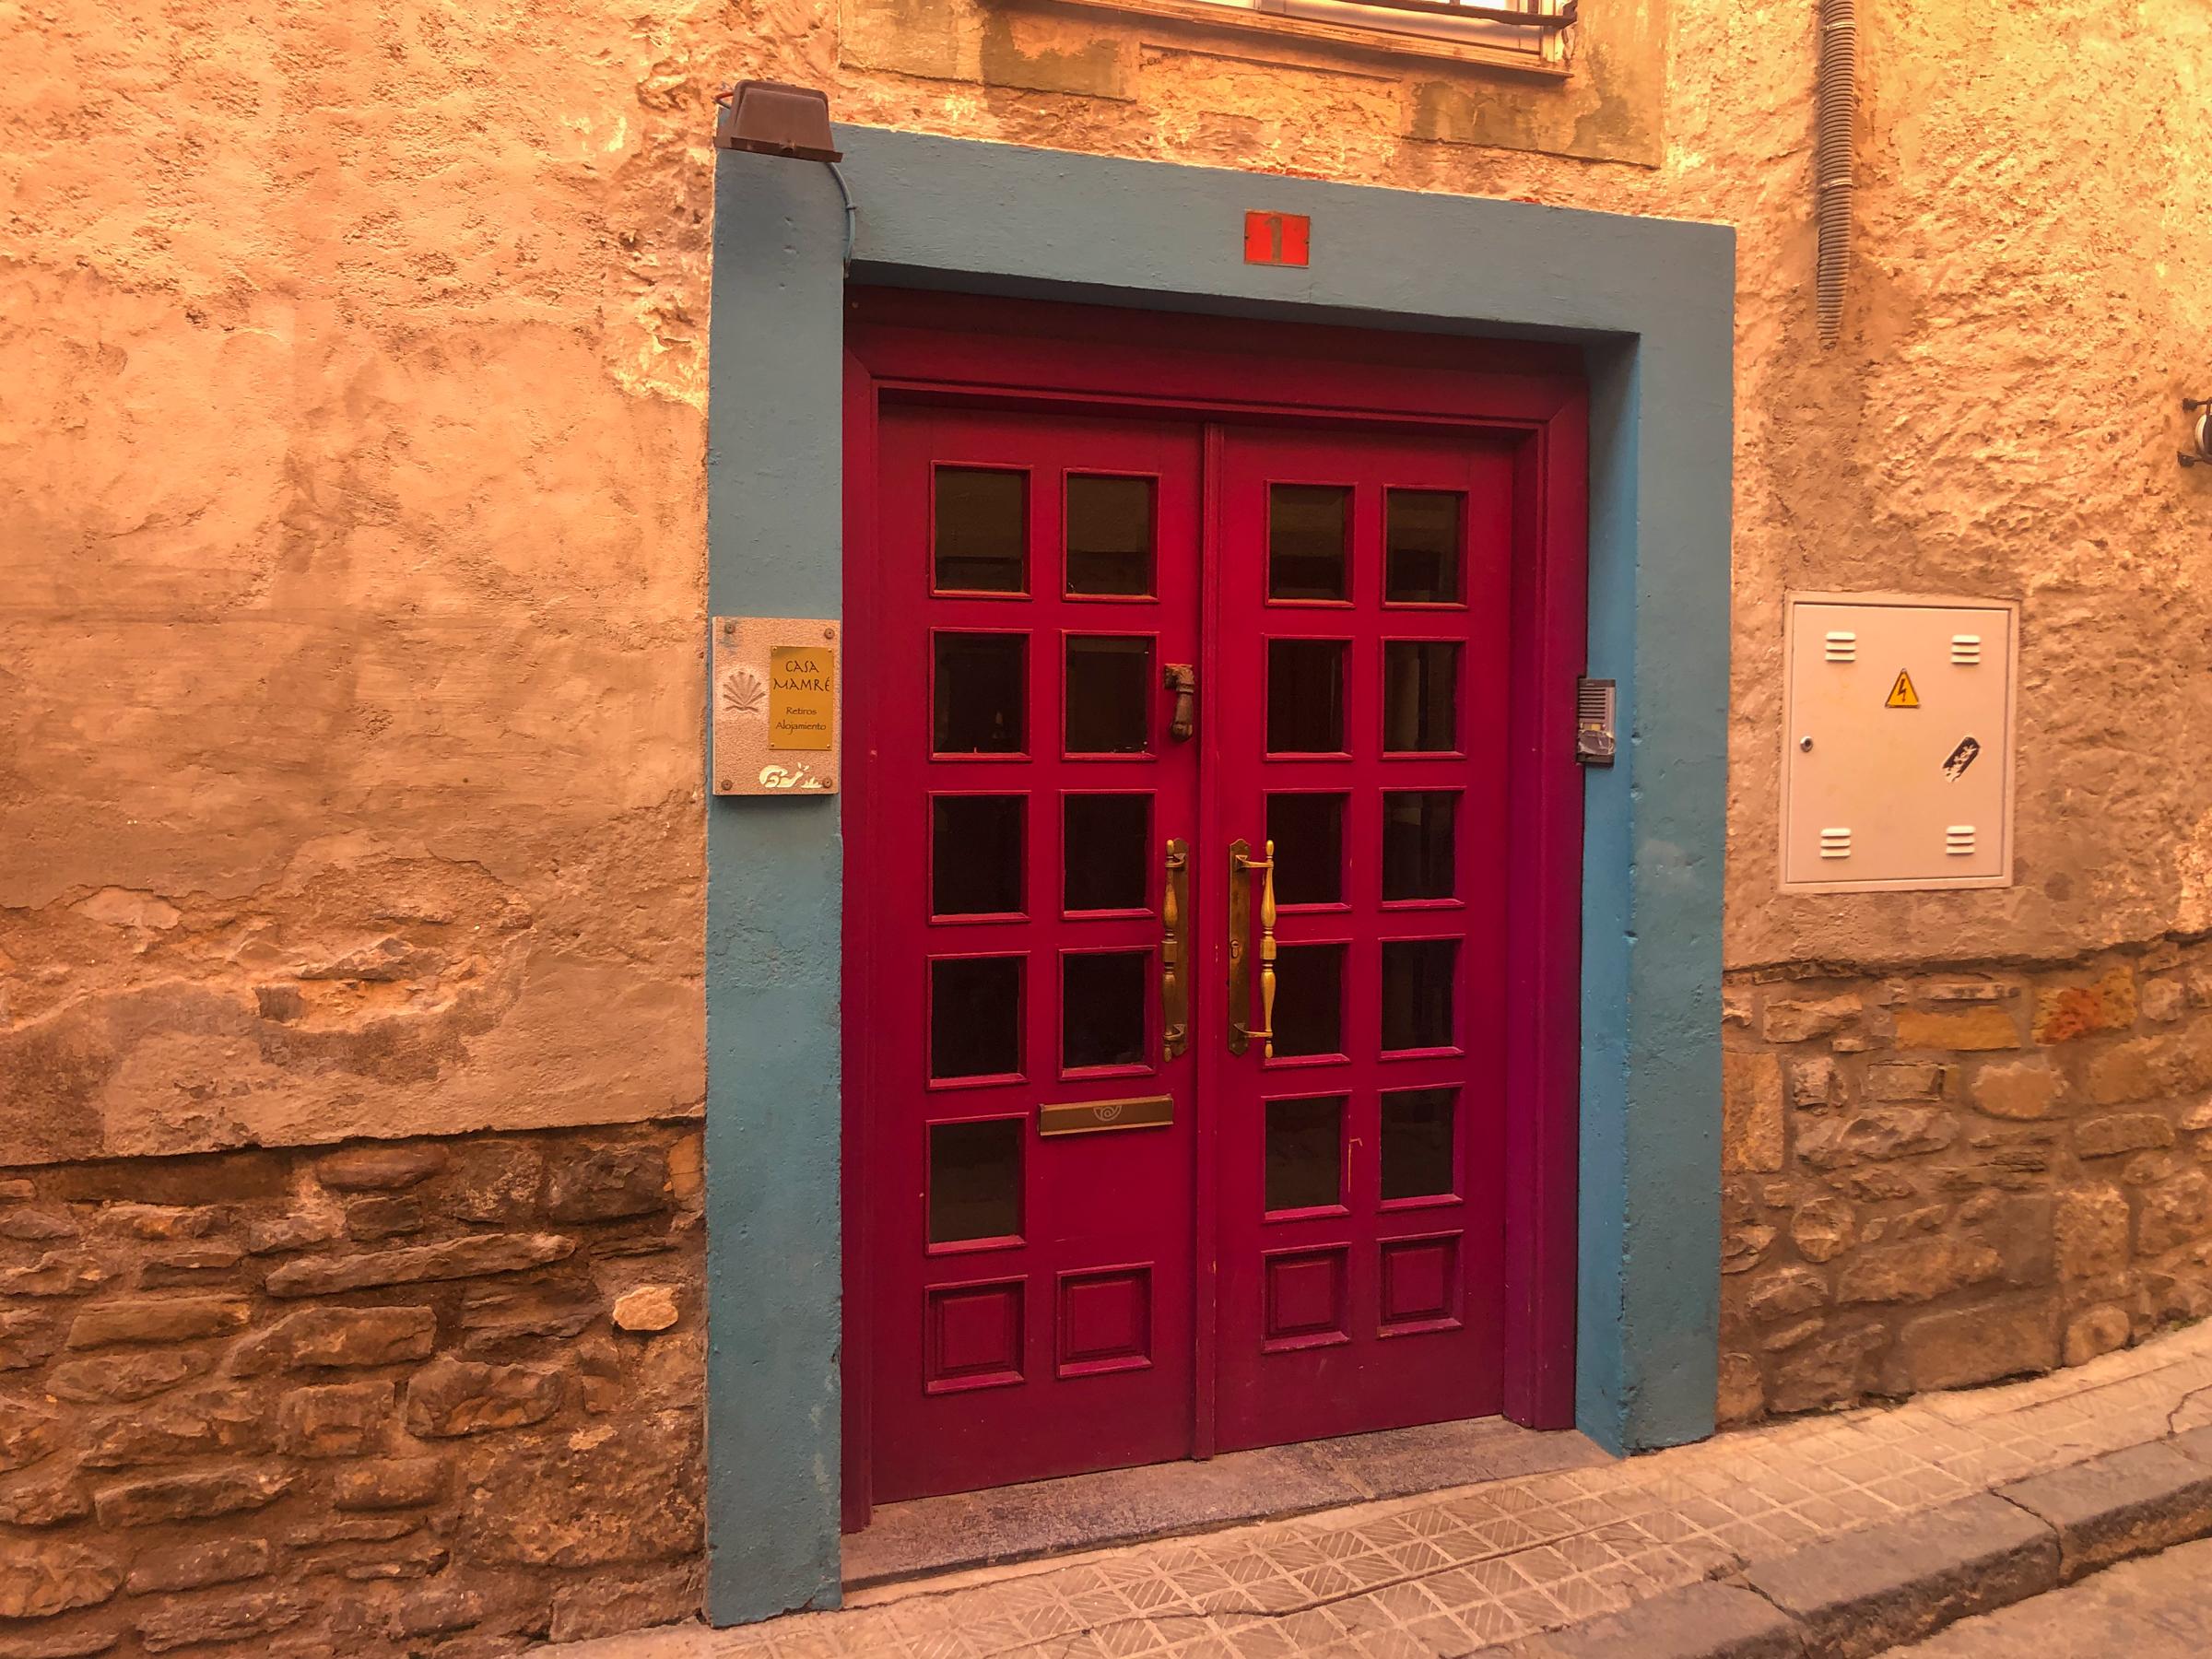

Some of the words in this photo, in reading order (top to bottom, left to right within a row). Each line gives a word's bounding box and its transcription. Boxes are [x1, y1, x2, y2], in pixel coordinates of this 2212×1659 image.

[1264, 216, 1283, 265] 1
[785, 660, 819, 673] CASA
[772, 677, 830, 692] MAMRÉ
[785, 706, 818, 715] Retiros
[775, 719, 827, 735] Alojamiento
